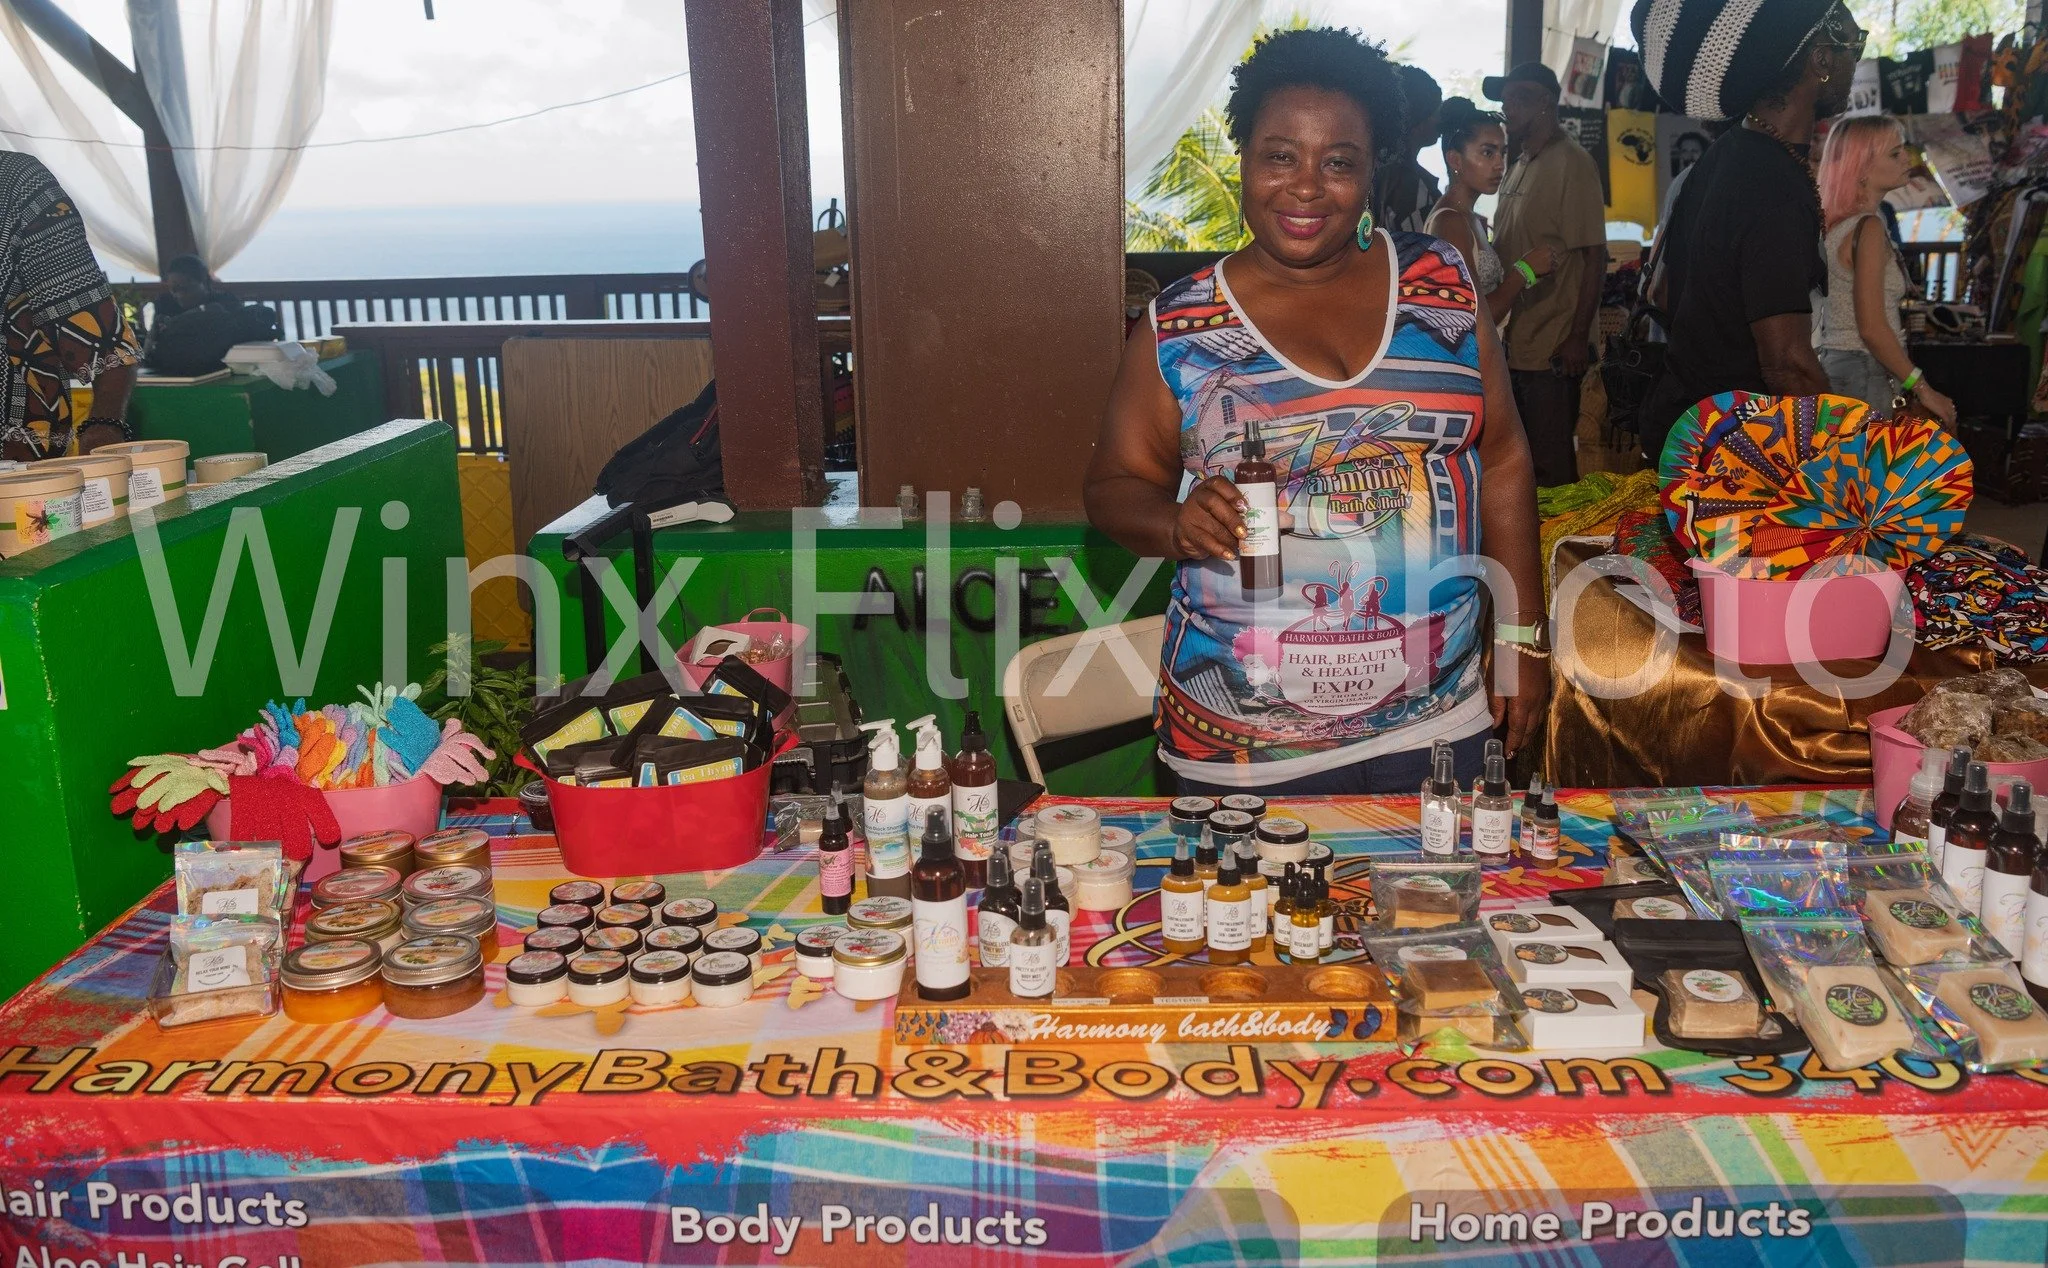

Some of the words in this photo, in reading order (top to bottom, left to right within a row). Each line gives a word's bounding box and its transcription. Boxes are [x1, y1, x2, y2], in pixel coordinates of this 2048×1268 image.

[1329, 499, 1365, 514] Bath
[1366, 496, 1378, 512] &
[1380, 494, 1413, 511] Body
[853, 566, 1067, 634] ALOE
[1285, 633, 1337, 643] HARMONY
[1338, 633, 1365, 642] BATH
[1367, 632, 1375, 641] &
[1377, 628, 1401, 639] BODY
[1288, 653, 1332, 667] HAIR,
[1336, 647, 1399, 664] BEAUTY
[1301, 667, 1314, 677] &
[1318, 663, 1385, 677] HEALTH
[1311, 678, 1374, 694] EXPO
[560, 711, 598, 737] Thyme
[615, 709, 636, 720] Tea
[673, 772, 696, 784] Tea
[699, 761, 739, 778] Thyme
[1025, 1011, 1168, 1044] Harmony
[1177, 1010, 1332, 1042] bath&body
[0, 1045, 1669, 1108] HarmonyBath&Body.com
[86, 1181, 309, 1228] Products
[671, 1202, 800, 1256] Body
[821, 1202, 1048, 1246] Products
[1410, 1201, 1560, 1241] Home
[1582, 1197, 1812, 1241] Products
